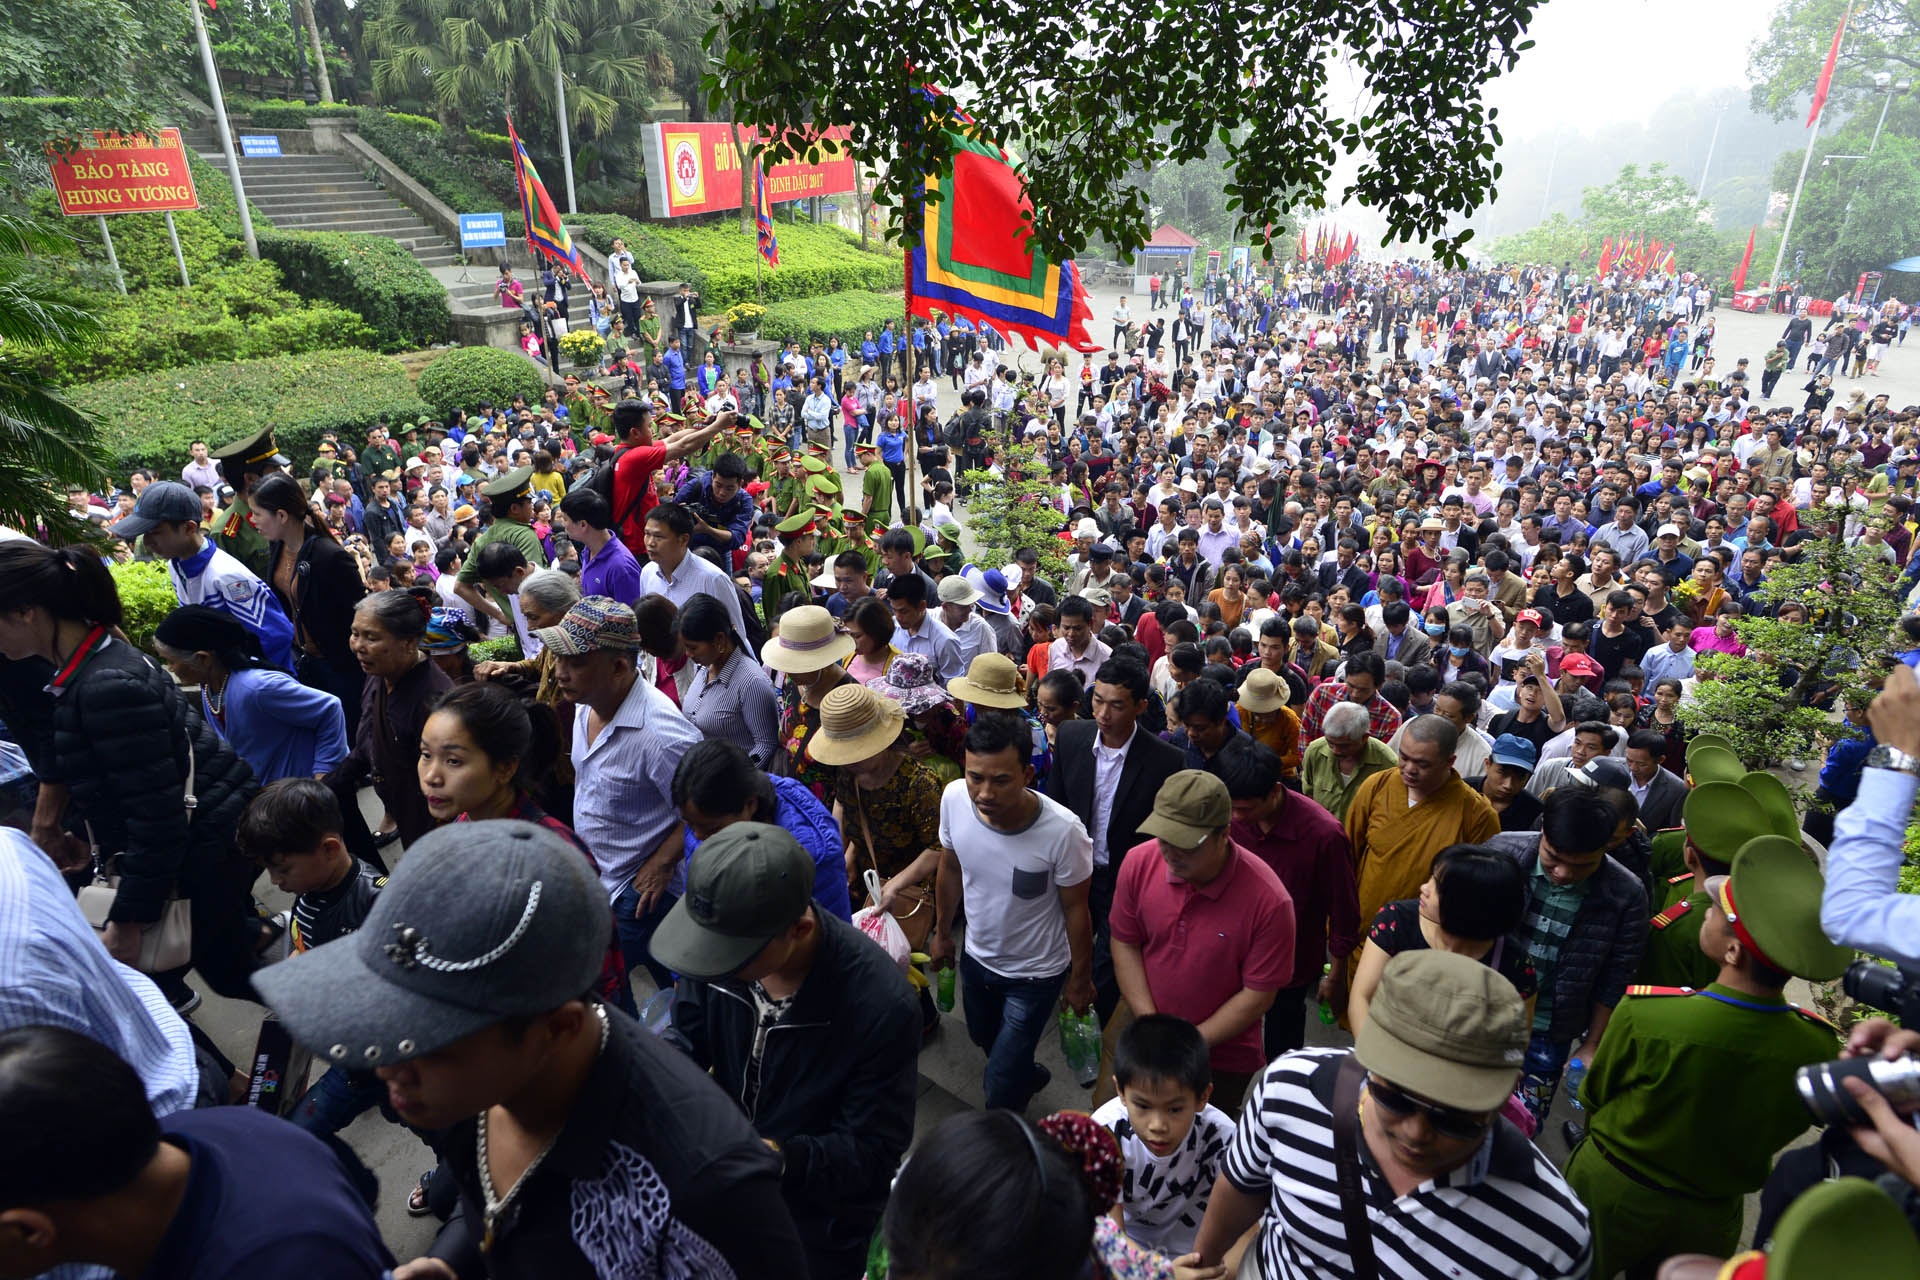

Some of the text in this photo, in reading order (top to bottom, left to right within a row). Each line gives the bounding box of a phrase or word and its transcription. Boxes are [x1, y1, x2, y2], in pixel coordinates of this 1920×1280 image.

[72, 158, 169, 179] BẢO TÀNG
[770, 176, 791, 194] ĐINH
[792, 170, 808, 195] DẬU
[809, 173, 824, 189] 2017
[65, 185, 190, 205] HÙNG VƯƠNG
